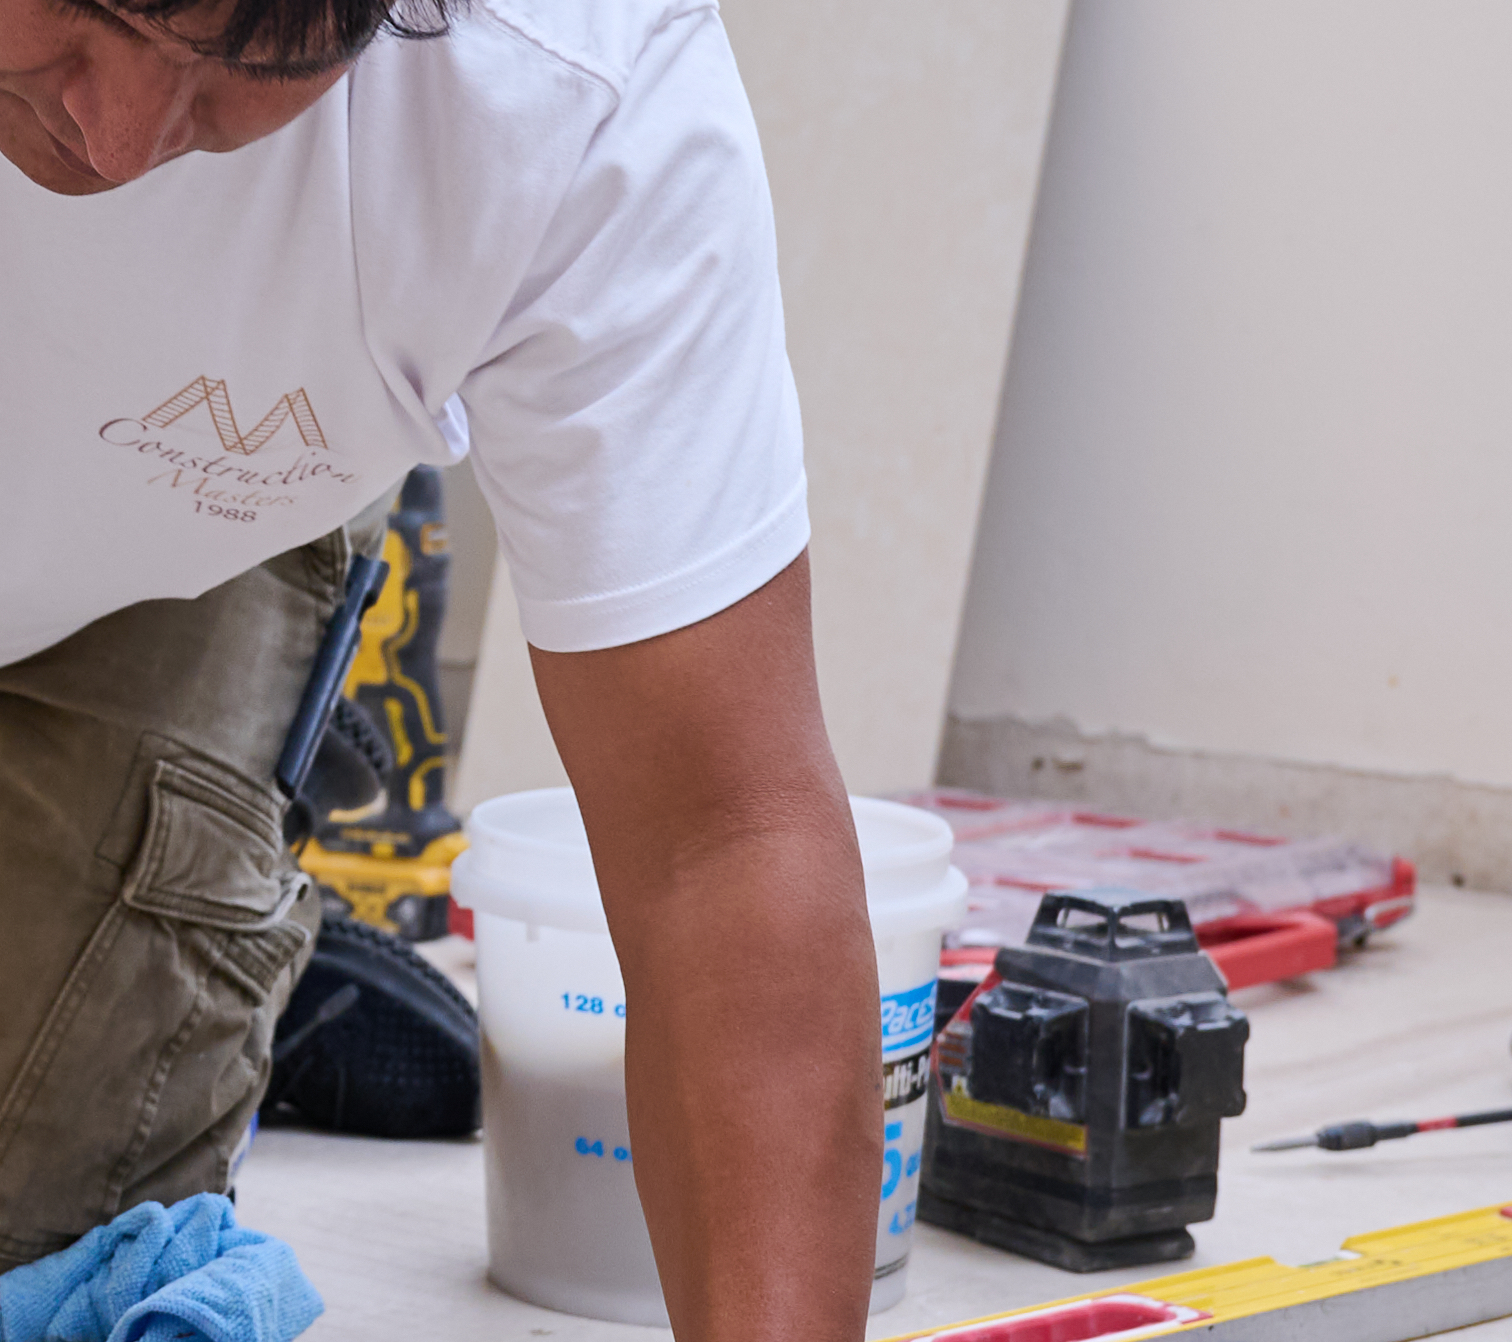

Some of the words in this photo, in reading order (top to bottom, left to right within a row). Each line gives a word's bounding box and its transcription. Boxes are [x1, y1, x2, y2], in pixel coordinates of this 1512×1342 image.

[98, 417, 361, 485] Construction
[147, 468, 296, 507] Masters
[194, 500, 258, 524] 1988
[561, 992, 604, 1015] 128
[575, 1136, 605, 1158] 64
